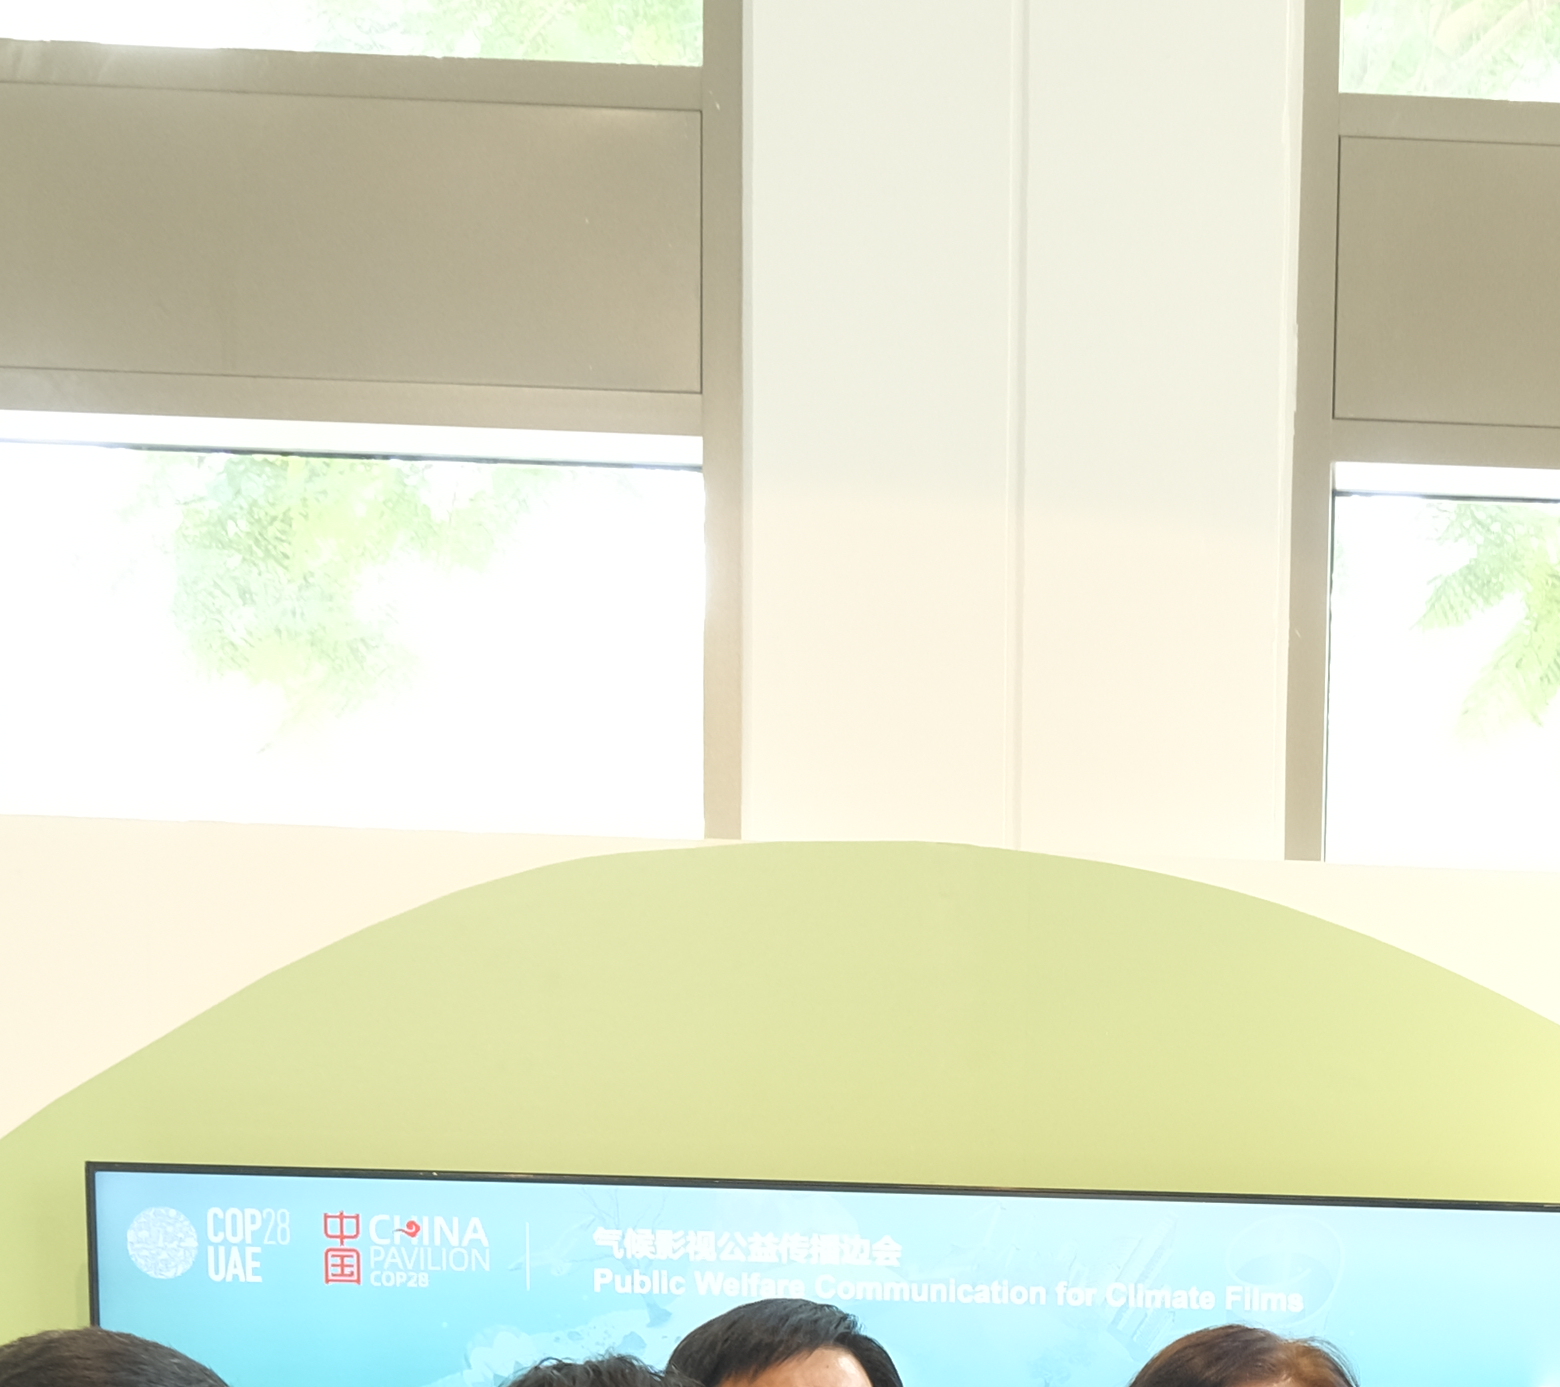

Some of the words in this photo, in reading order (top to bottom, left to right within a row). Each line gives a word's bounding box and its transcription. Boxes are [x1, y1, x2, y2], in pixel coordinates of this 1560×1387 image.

[207, 1207, 290, 1245] COP28
[369, 1214, 489, 1247] CHINA
[207, 1246, 263, 1283] UAE
[369, 1246, 490, 1273] PAVILION
[369, 1271, 430, 1288] COP28
[593, 1268, 686, 1295] Public
[694, 1269, 805, 1299] Welfare
[815, 1274, 1046, 1306] Communication
[1055, 1280, 1098, 1307] for
[1106, 1282, 1215, 1311] Climate
[1226, 1285, 1305, 1313] Films
